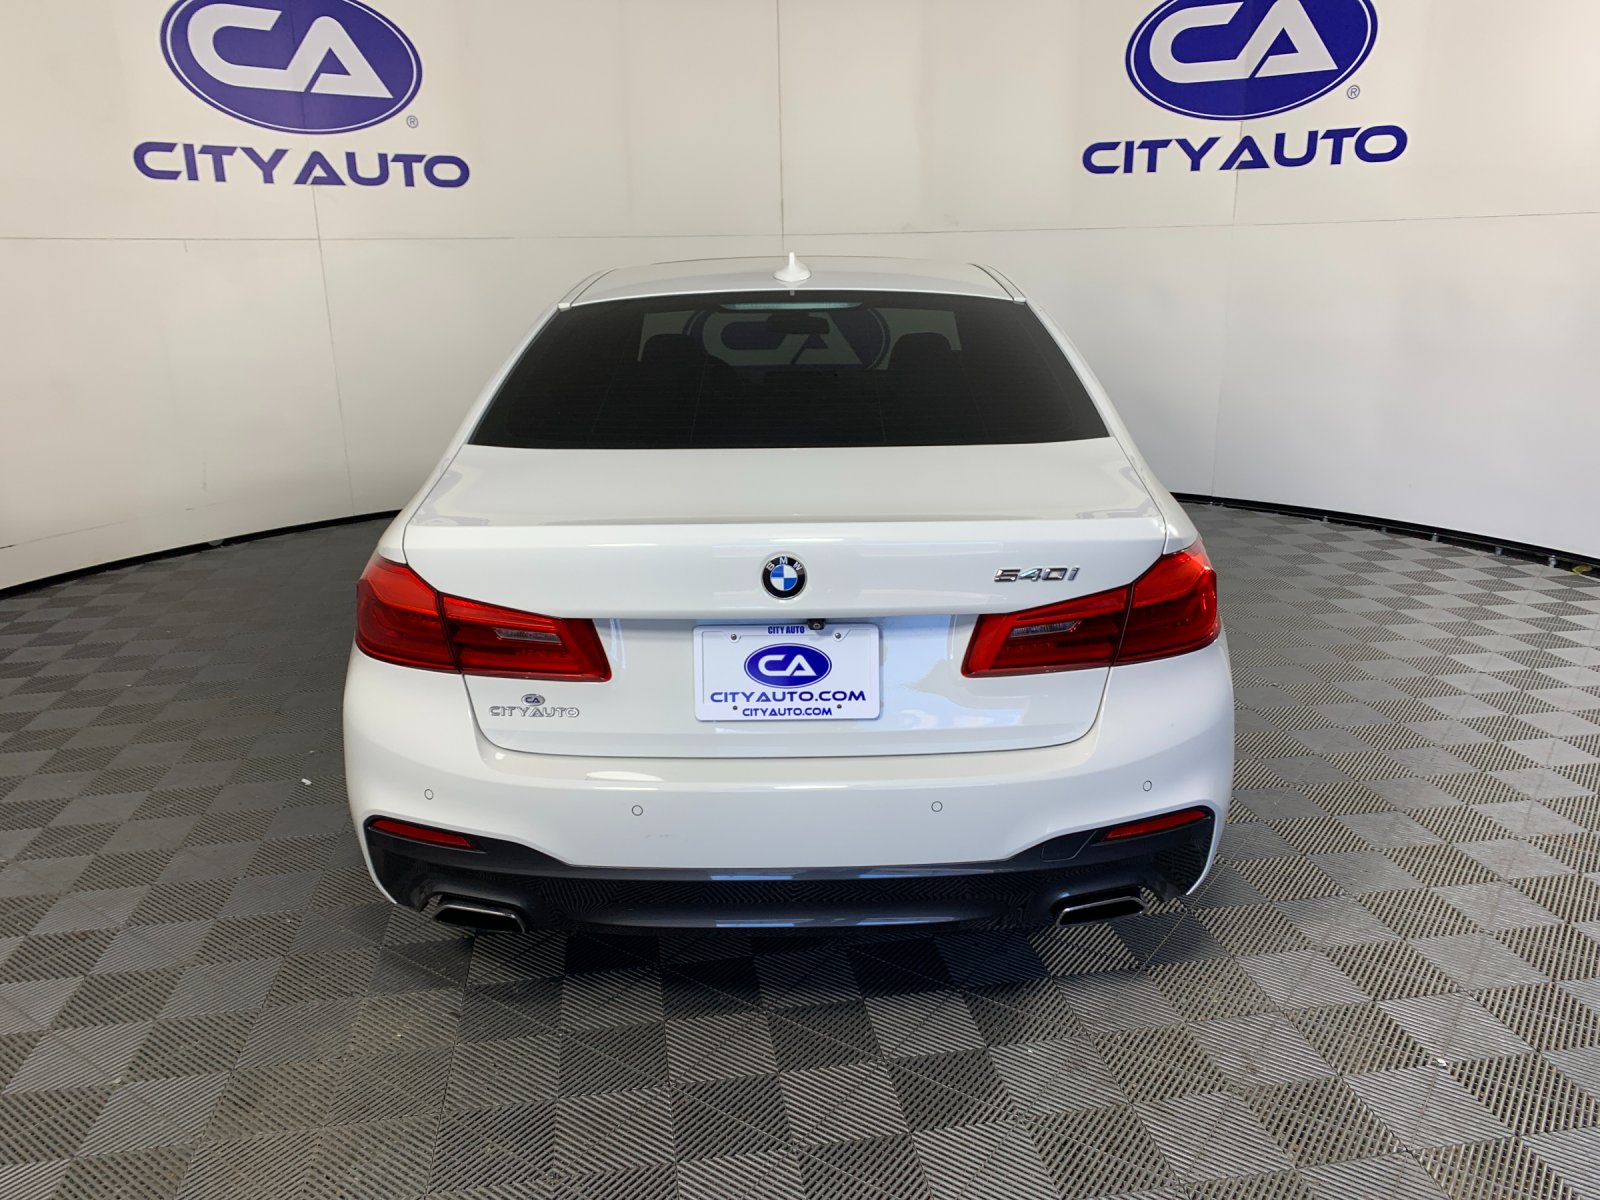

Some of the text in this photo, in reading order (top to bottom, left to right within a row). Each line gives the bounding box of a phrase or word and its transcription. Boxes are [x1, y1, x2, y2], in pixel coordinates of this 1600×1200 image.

[1149, 0, 1339, 84] CA
[187, 3, 394, 99] CA
[766, 555, 802, 571] BMW
[994, 567, 1080, 582] 540i
[767, 625, 805, 635] CITY AUTO
[757, 654, 818, 677] CA
[710, 690, 867, 703] CITYAUTO.COM
[742, 706, 833, 717] CITYAUTO.COM
